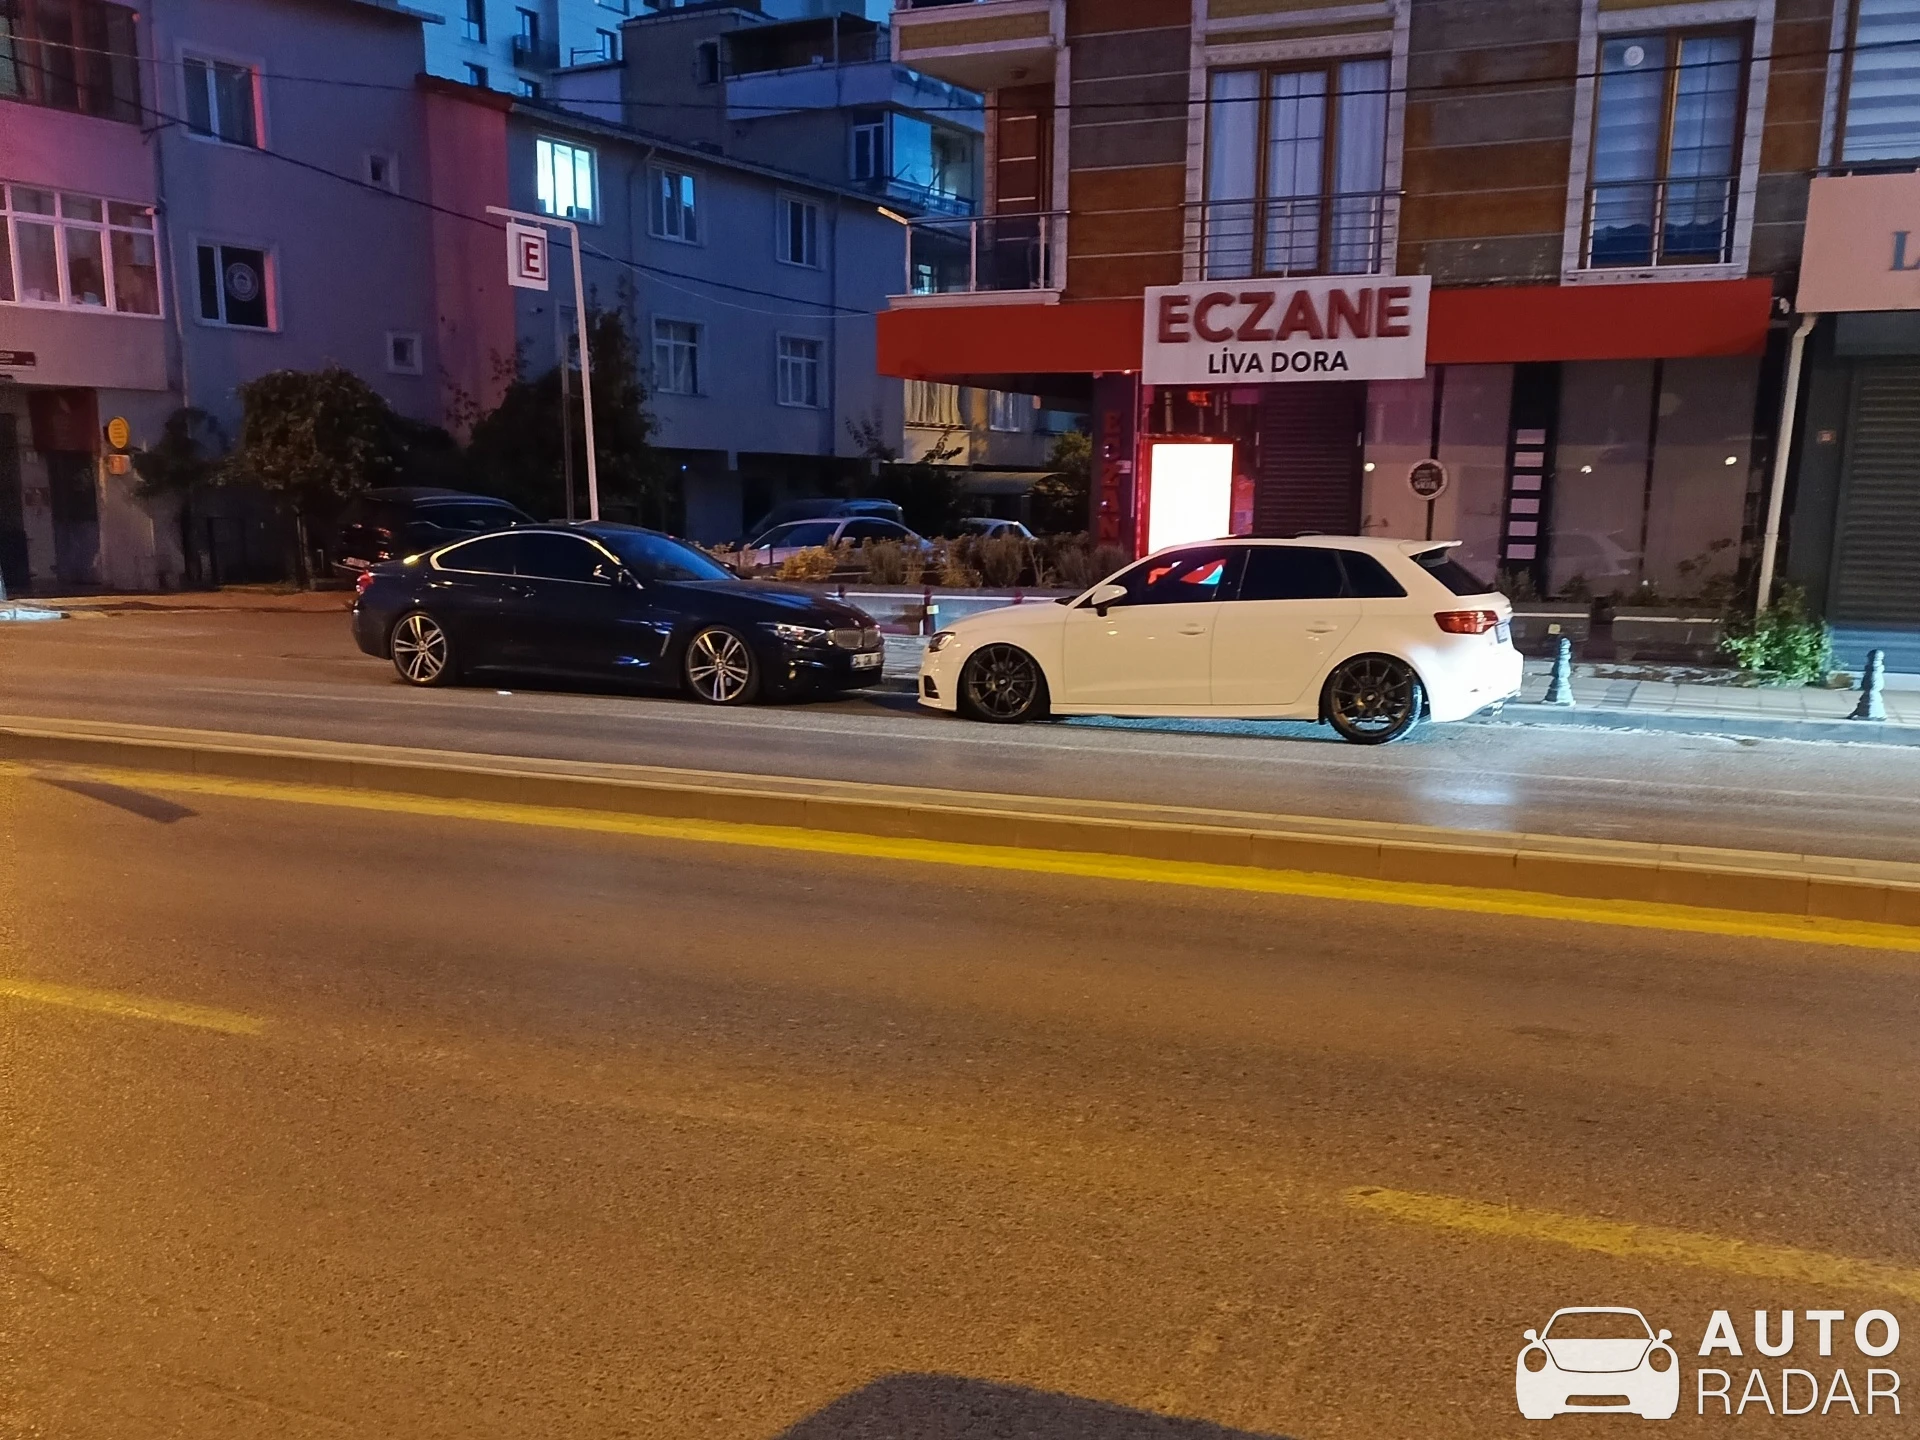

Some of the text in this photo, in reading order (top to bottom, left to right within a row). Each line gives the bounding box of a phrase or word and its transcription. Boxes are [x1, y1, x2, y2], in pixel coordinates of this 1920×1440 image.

[524, 241, 540, 273] E
[1158, 286, 1411, 343] ECZANE
[1208, 347, 1349, 374] LİVA DORA
[1098, 411, 1121, 543] ECZAN
